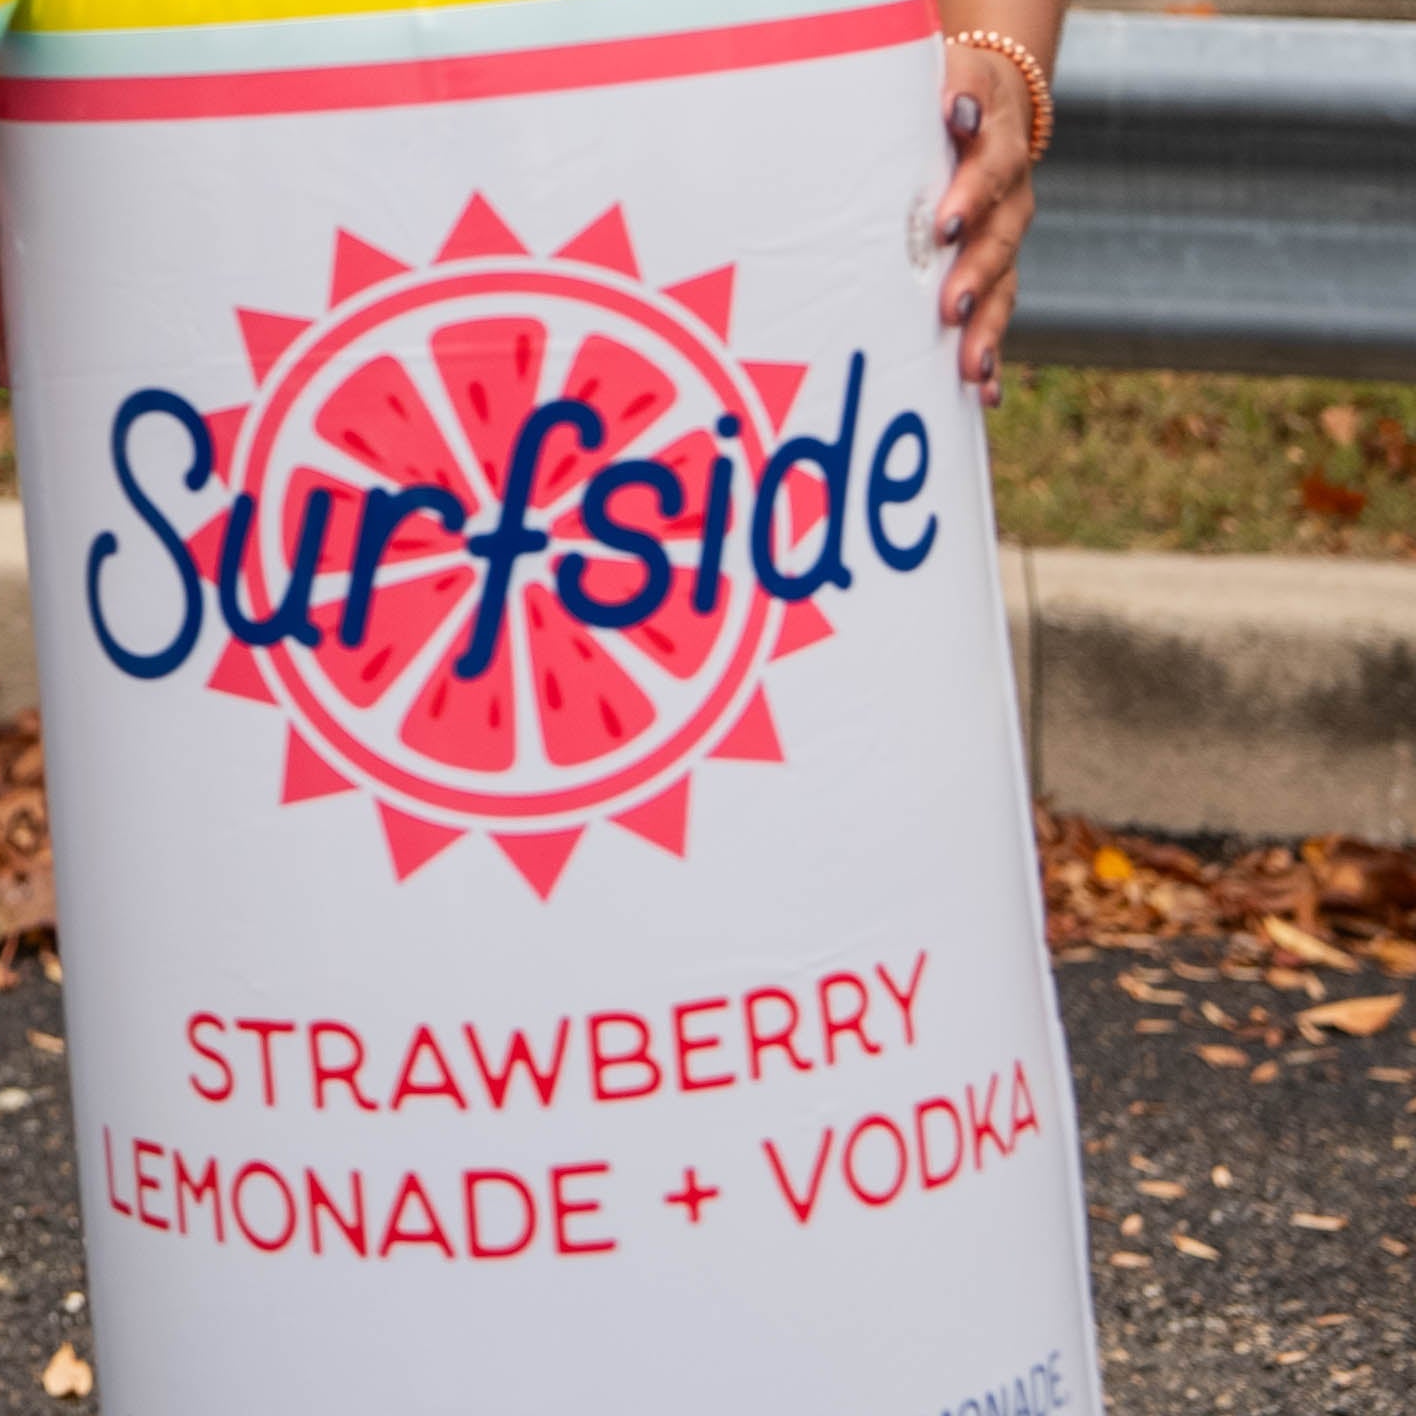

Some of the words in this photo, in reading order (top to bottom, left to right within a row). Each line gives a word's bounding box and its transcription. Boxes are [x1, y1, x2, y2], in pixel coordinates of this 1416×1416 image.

[87, 350, 938, 679] Surfside
[186, 950, 927, 1113] STRAWBERRY
[102, 1125, 618, 1261] LEMONADE
[663, 1167, 720, 1224] +
[761, 1061, 1041, 1226] VODKA
